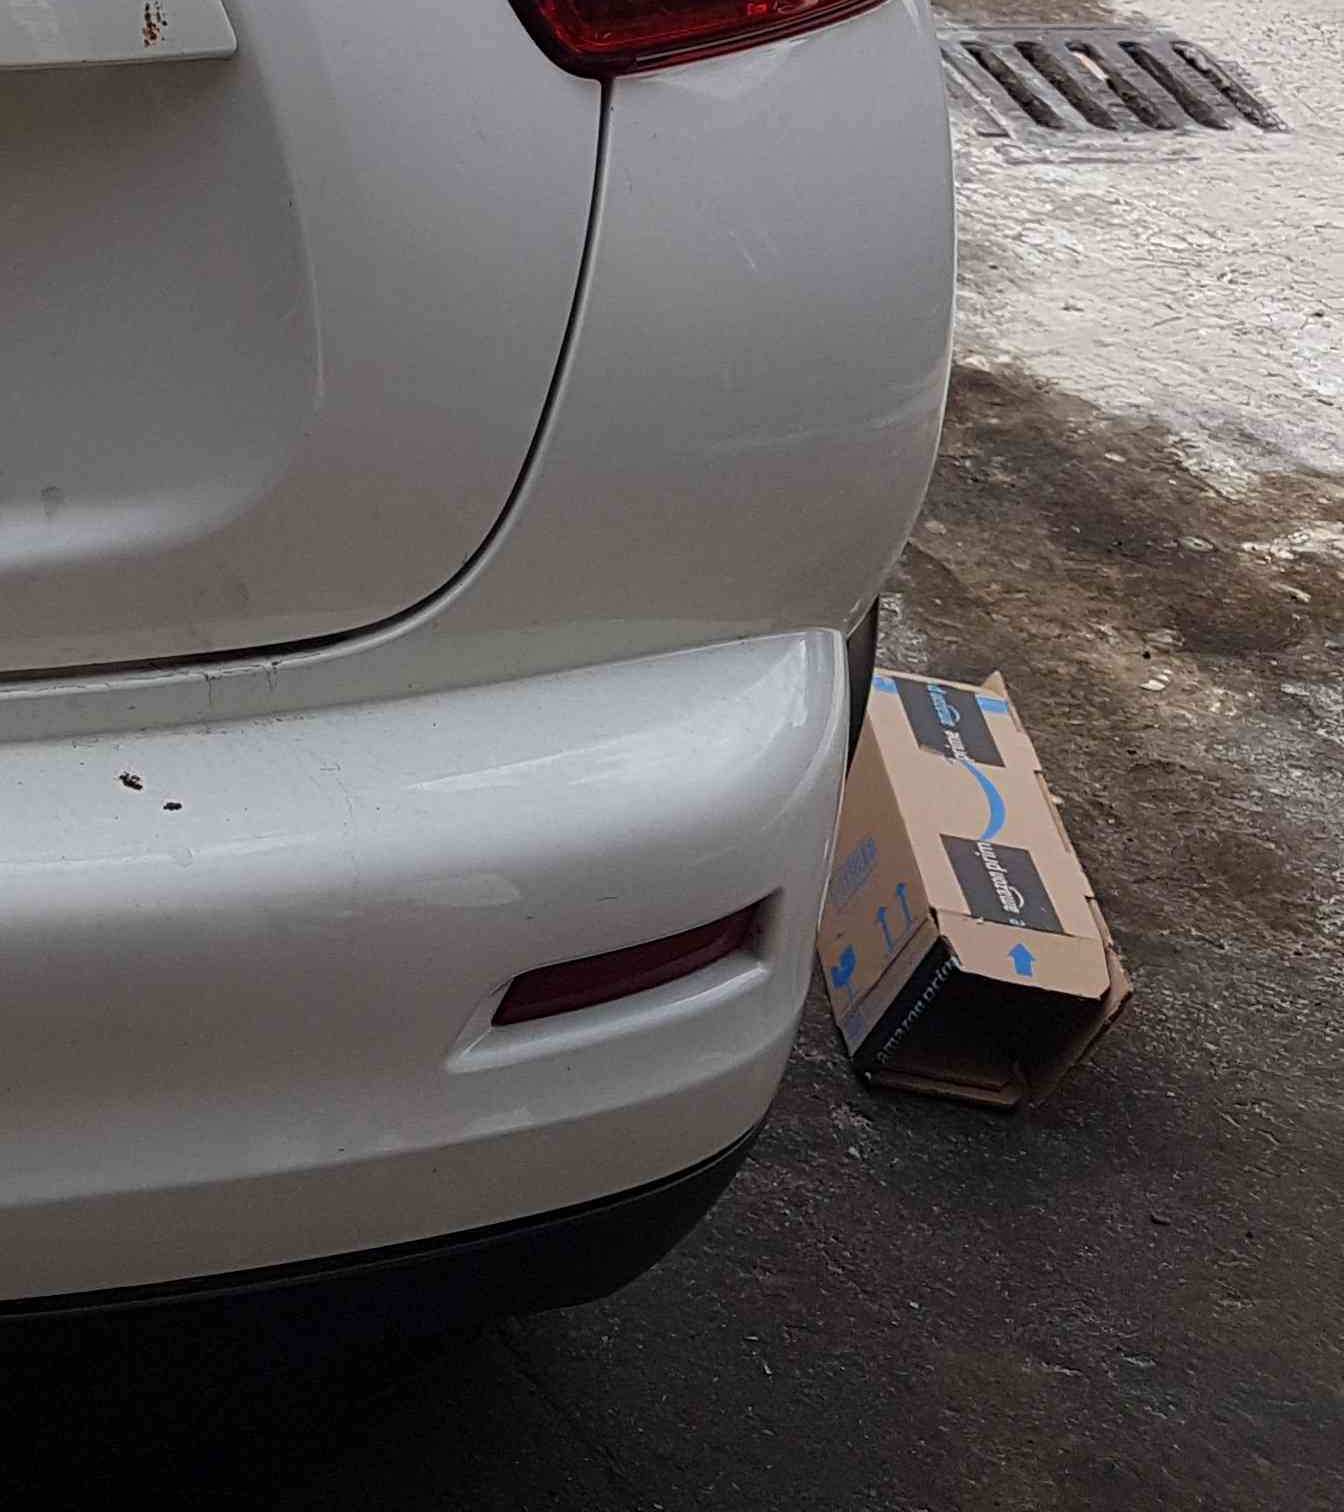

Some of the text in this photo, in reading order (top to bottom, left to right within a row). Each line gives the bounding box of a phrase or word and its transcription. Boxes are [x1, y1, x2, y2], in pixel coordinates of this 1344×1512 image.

[973, 840, 1008, 873] prim
[988, 871, 1024, 914] amazon
[875, 956, 964, 1065] amazon prim
